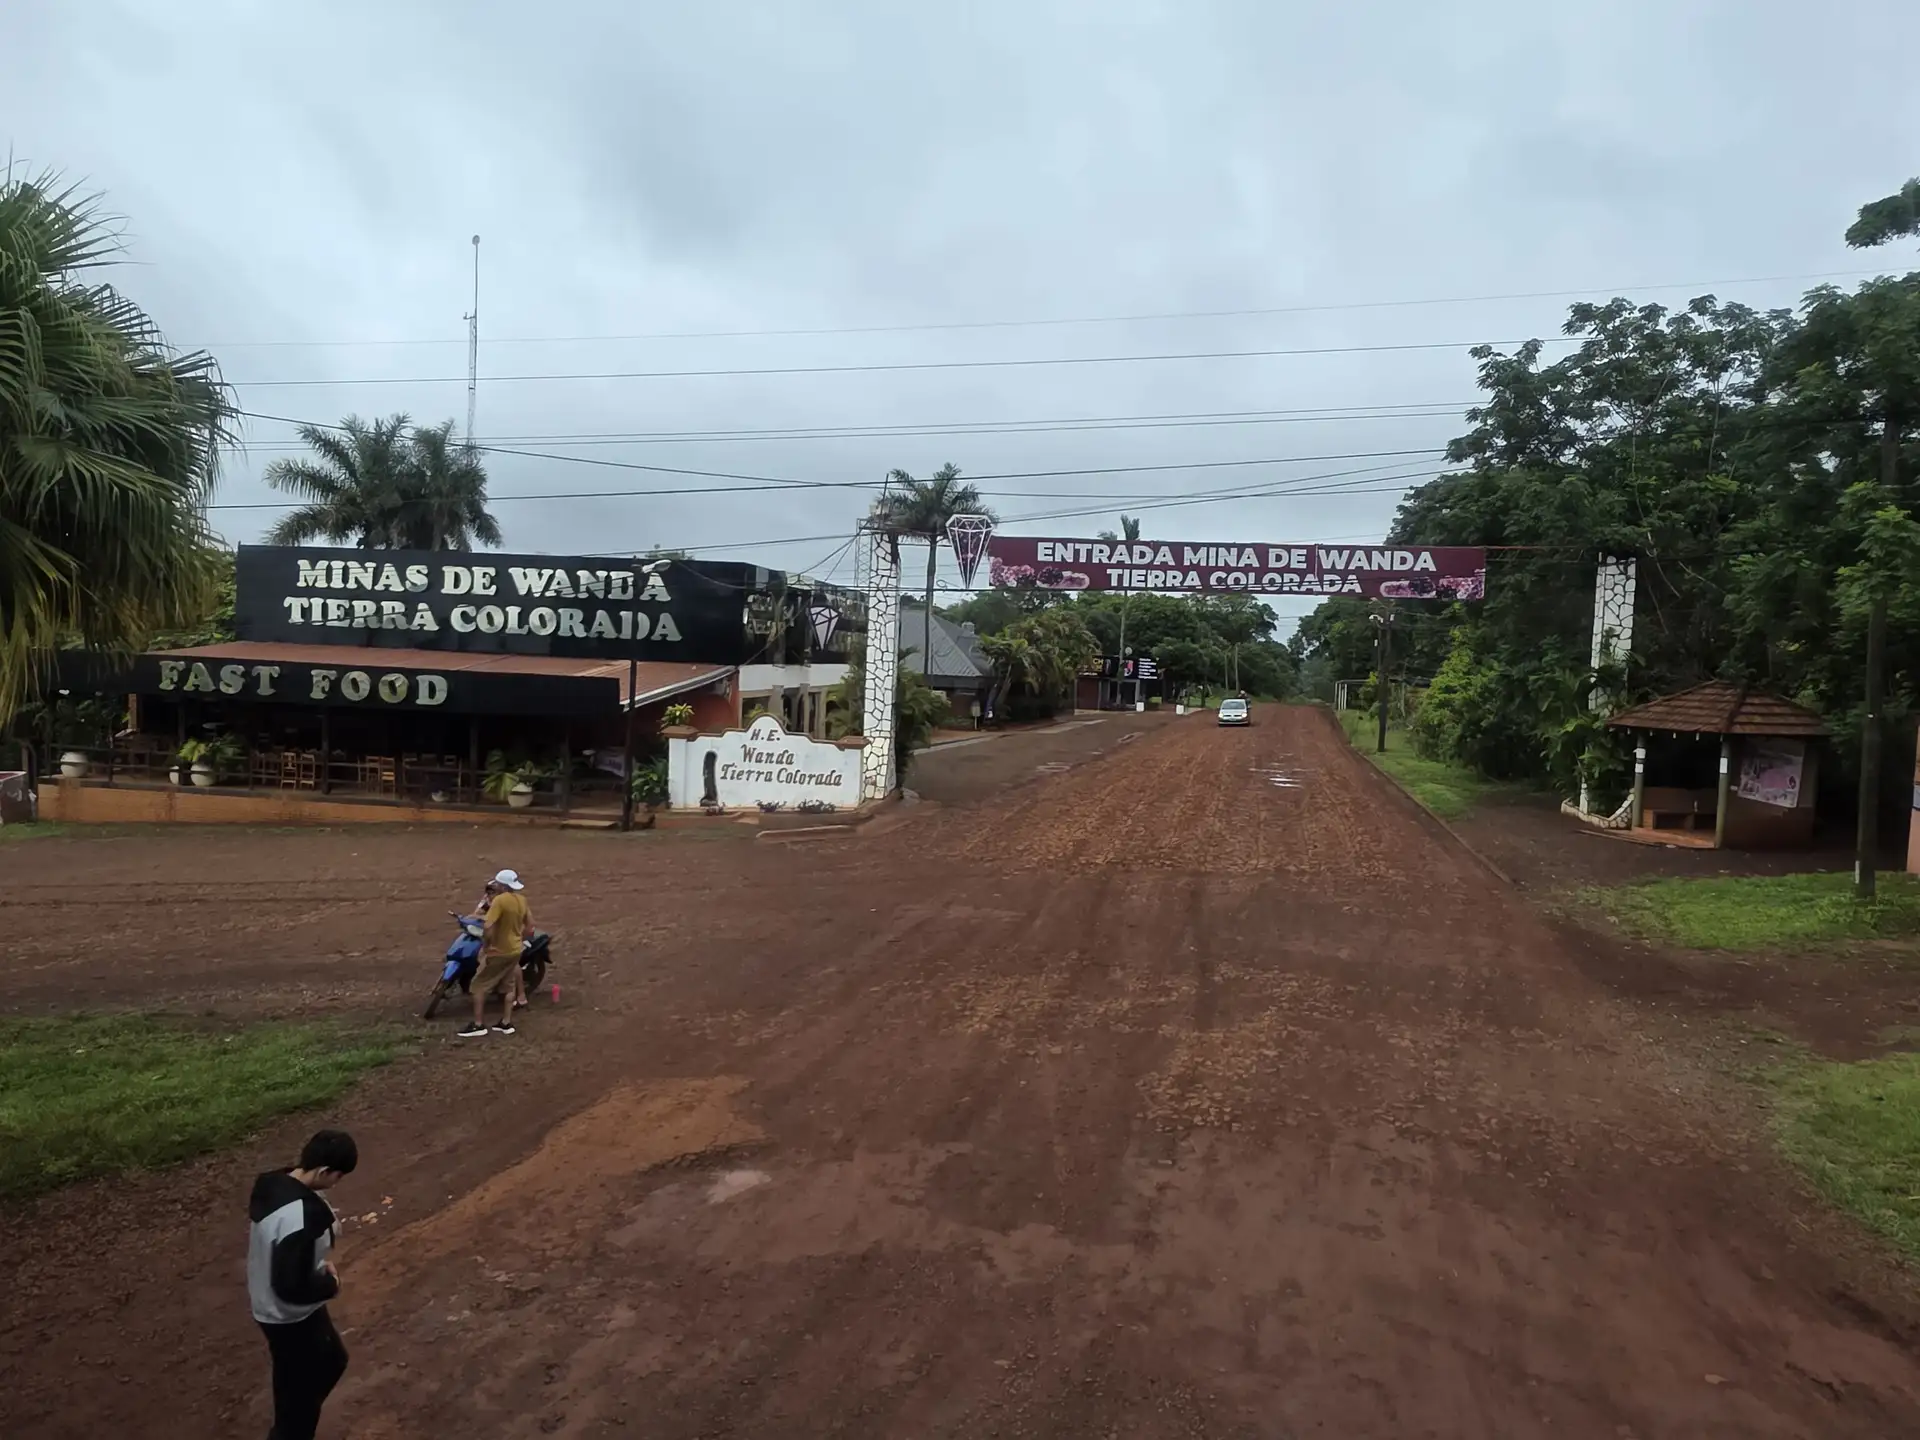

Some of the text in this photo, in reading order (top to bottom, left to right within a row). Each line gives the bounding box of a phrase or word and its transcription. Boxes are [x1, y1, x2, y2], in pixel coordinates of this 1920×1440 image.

[1037, 541, 1437, 572] ENTRADA MINA DE WANDA
[296, 559, 672, 602] MINAS DE WANDA
[1106, 568, 1363, 594] TIERRA COLORADA
[283, 596, 683, 642] TIERRA COLORADA
[158, 660, 449, 706] FAST FOOD
[740, 744, 795, 765] Wanda
[720, 762, 842, 787] Tierra Colorada
